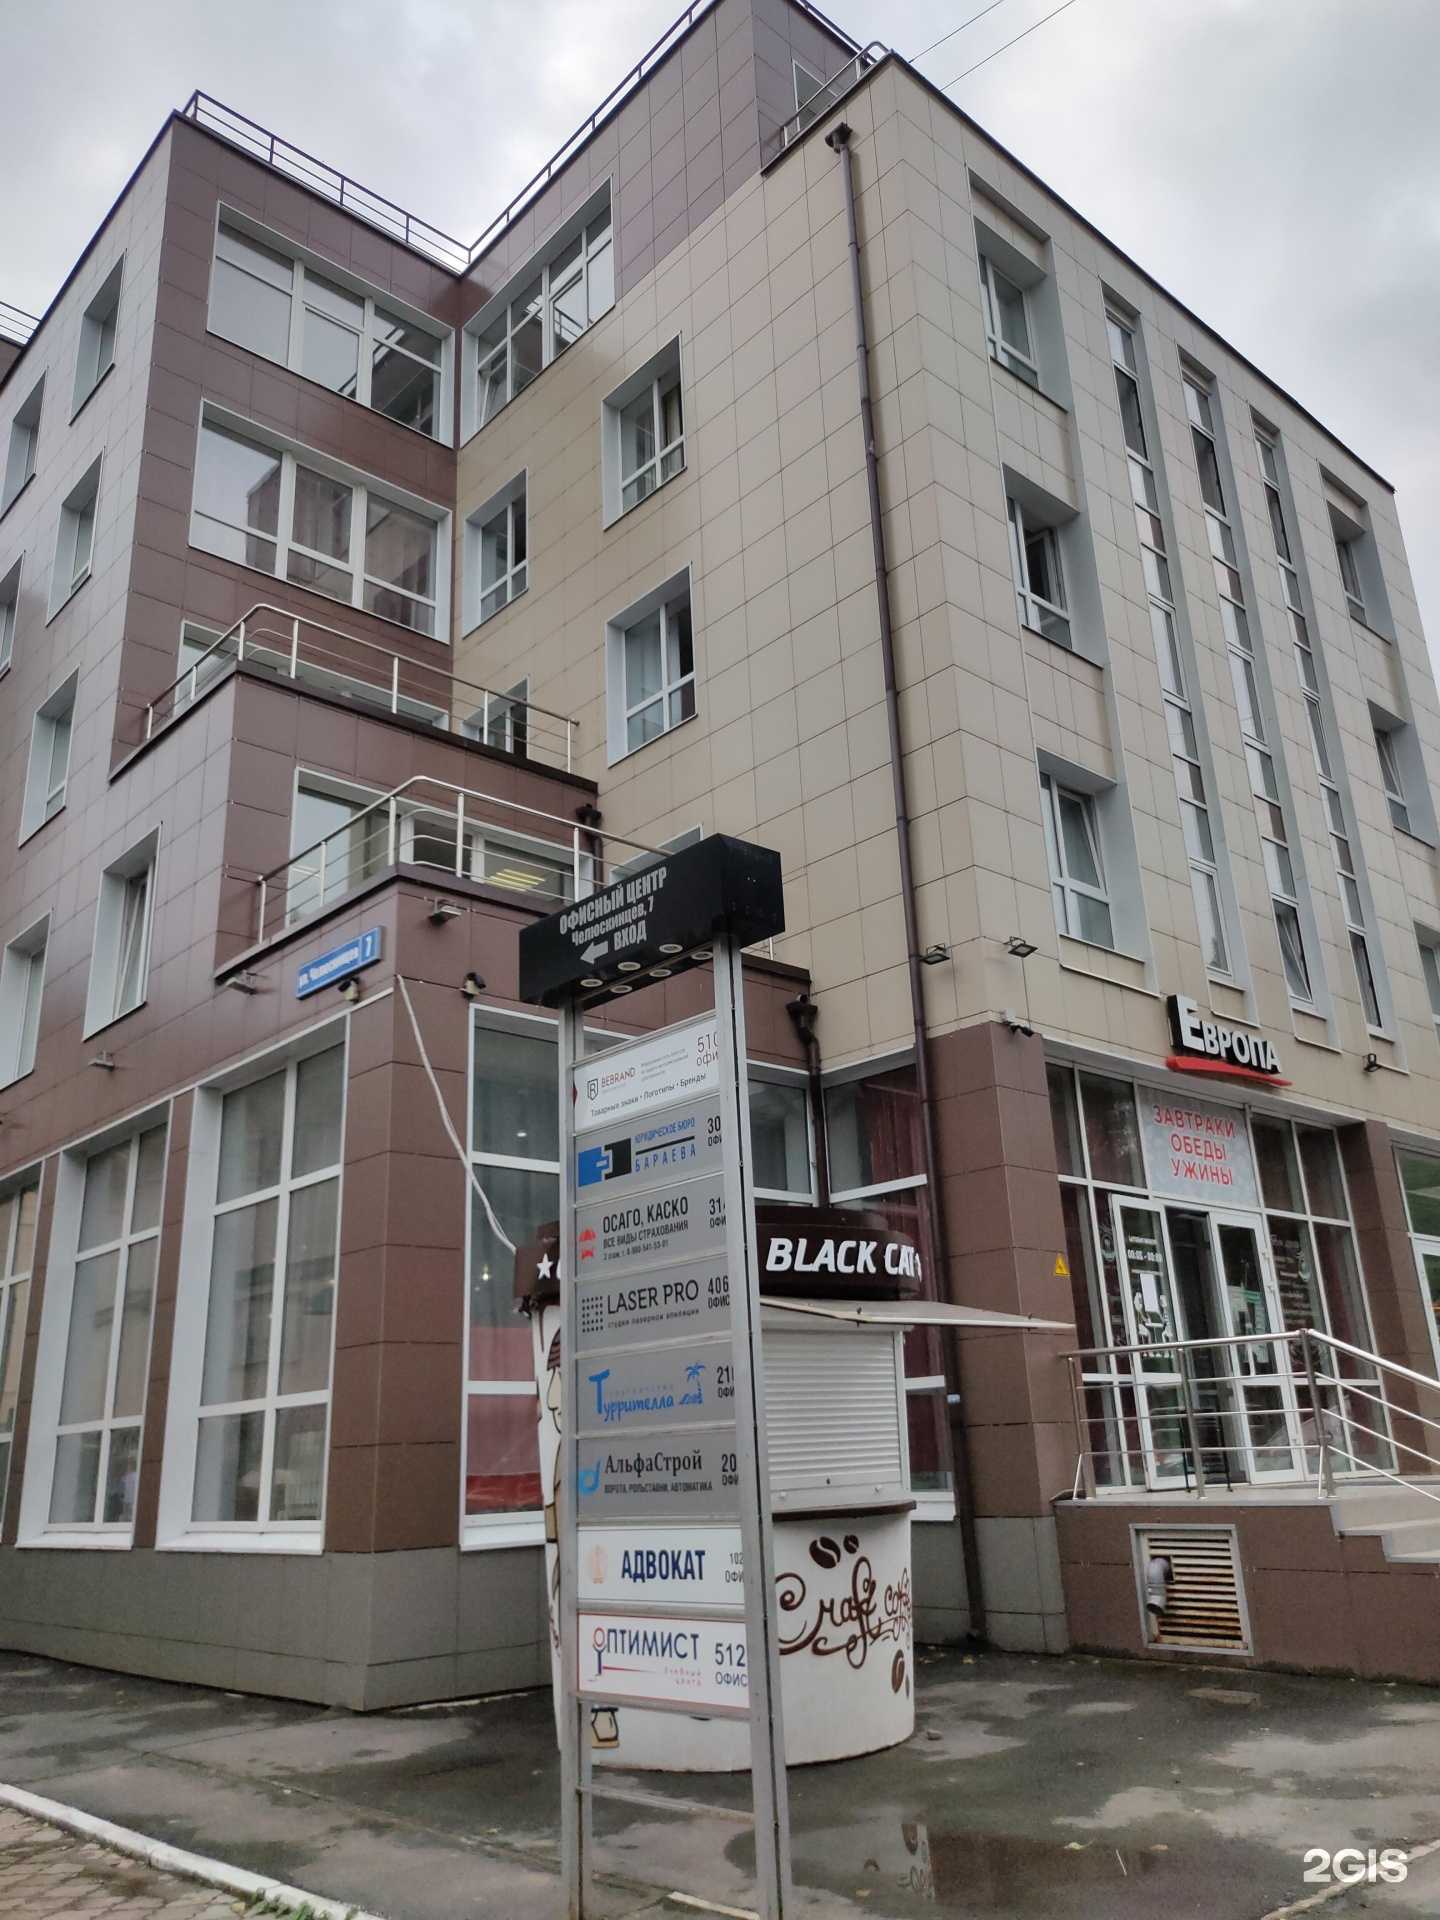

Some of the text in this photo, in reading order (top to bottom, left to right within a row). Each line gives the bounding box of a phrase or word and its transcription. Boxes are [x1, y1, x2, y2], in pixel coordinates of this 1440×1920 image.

[559, 867, 667, 935] ОФИСНЫЙ ЦЕНТР
[647, 895, 654, 912] 7
[613, 920, 647, 951] ВХОД
[601, 1067, 636, 1088] BEBRAND
[680, 1073, 706, 1089] Бренды
[707, 1116, 721, 1134] 30
[1153, 1105, 1236, 1138] ЗАВТРАКИ
[635, 1143, 696, 1172] БАРАЕВА
[1170, 1133, 1227, 1161] ОБЕДЫ
[1171, 1158, 1233, 1185] УЖИНЫ
[646, 1196, 689, 1224] КАСКО
[709, 1197, 726, 1216] 31
[616, 1232, 638, 1247] ВИДЫ
[638, 1220, 689, 1241] СТРАХОВАНИЯ
[765, 1237, 878, 1274] BLACK
[607, 1279, 699, 1315] LASER PRO
[707, 1274, 730, 1295] 406
[707, 1294, 730, 1310] ОФИС
[604, 1449, 702, 1478] АльфаСтрой
[721, 1453, 737, 1473] 20
[621, 1550, 706, 1583] АДВОКАТ
[593, 1627, 700, 1661] ОПТИМИСТ
[715, 1643, 746, 1668] 512
[715, 1671, 748, 1688] ОФИС
